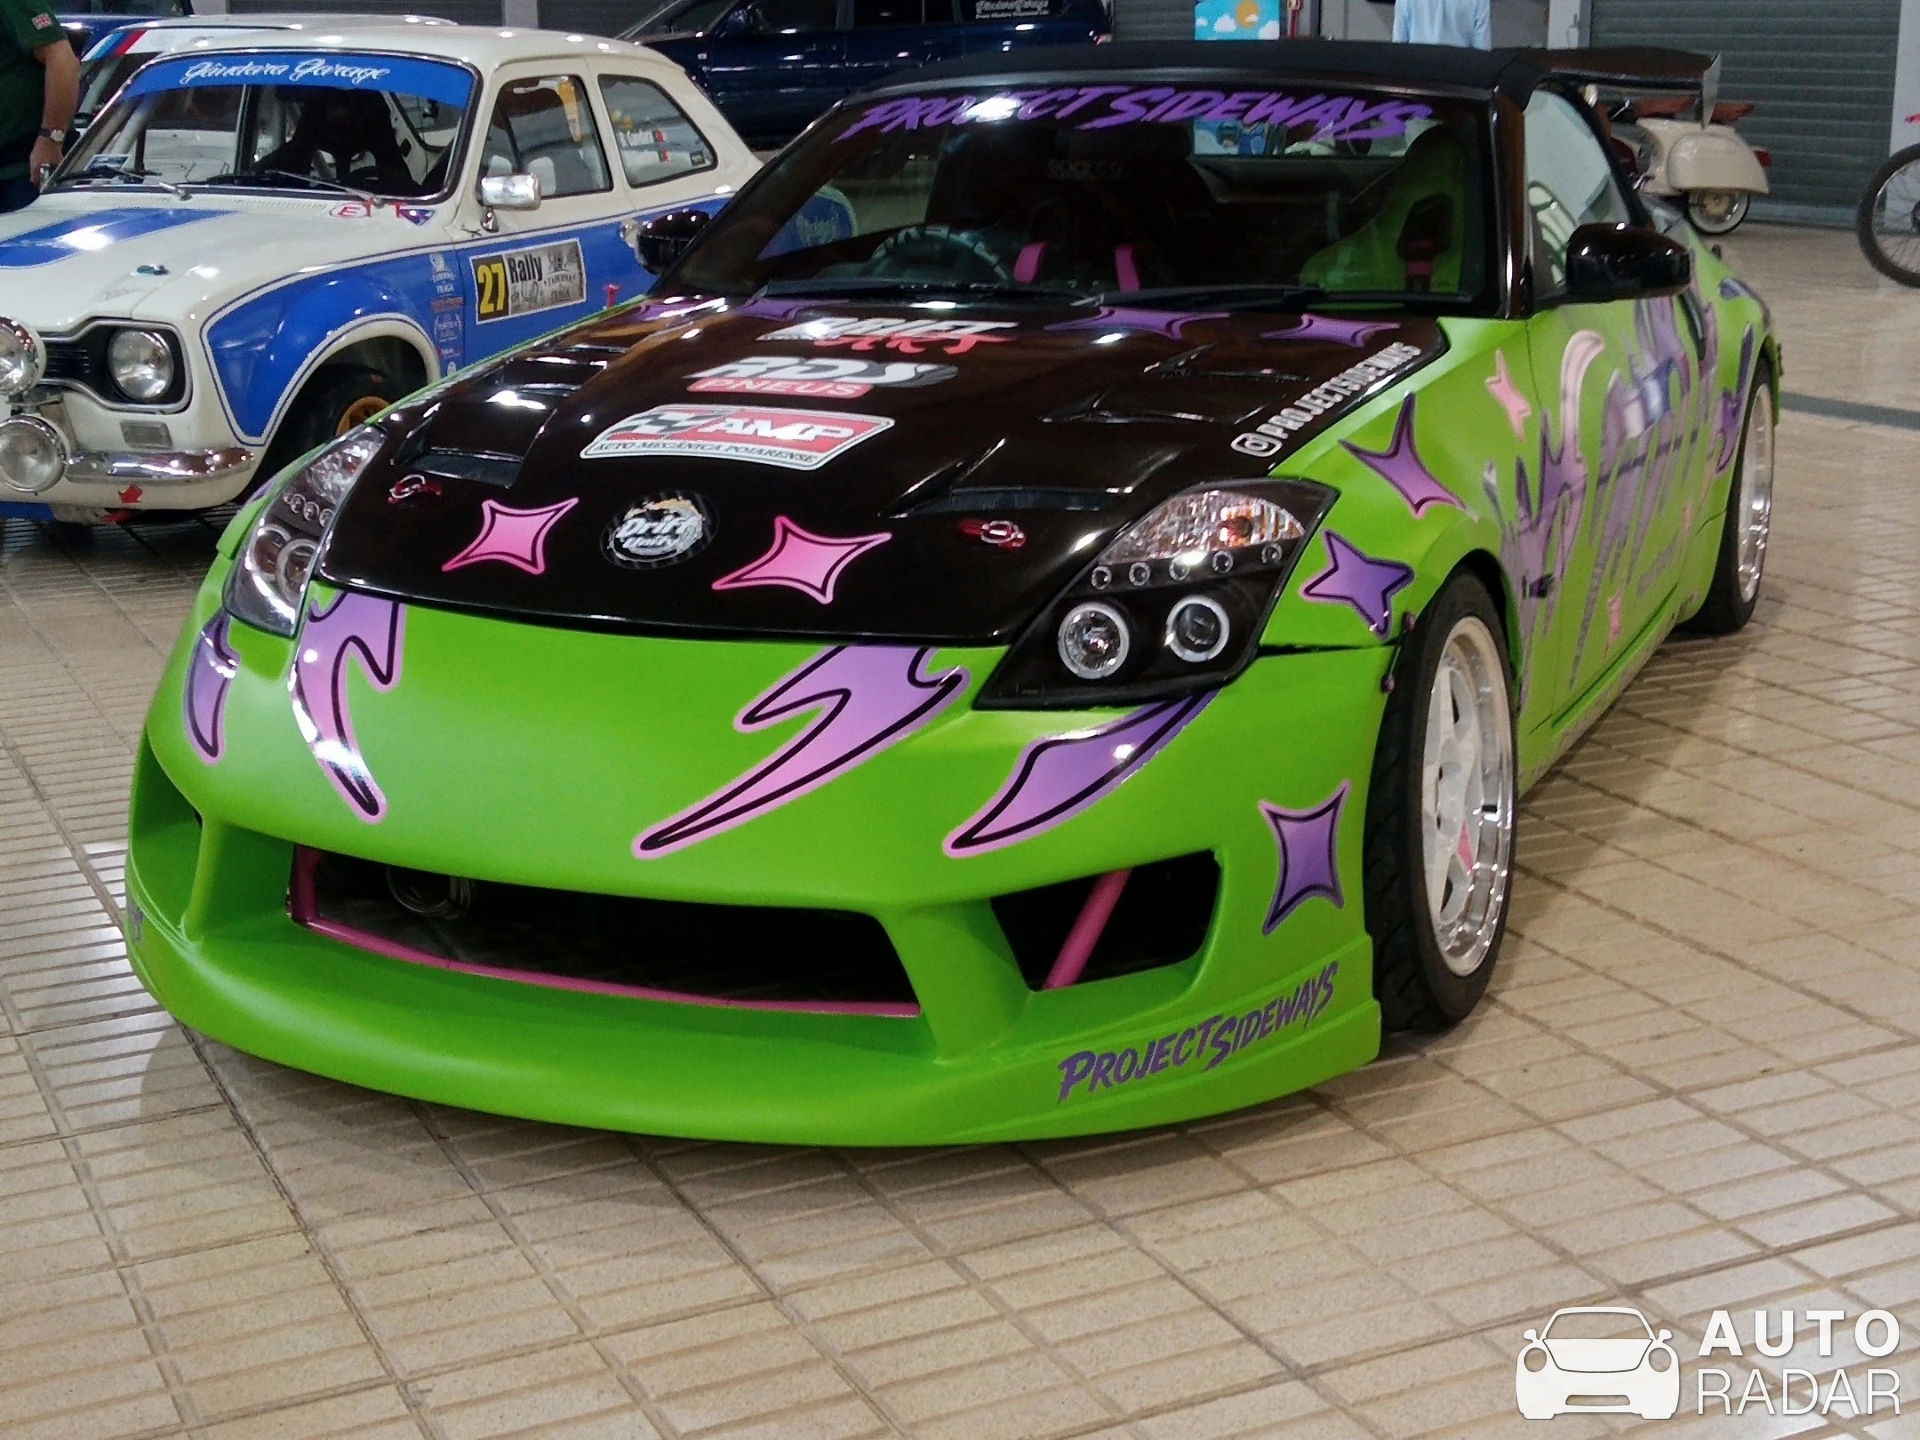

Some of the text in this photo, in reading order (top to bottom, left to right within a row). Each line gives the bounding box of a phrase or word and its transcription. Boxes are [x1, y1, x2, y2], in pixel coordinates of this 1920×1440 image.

[288, 58, 390, 84] Garage
[509, 253, 543, 284] Rally
[477, 262, 506, 314] 27
[695, 378, 858, 397] PNEUS
[697, 417, 855, 442] AMP
[596, 442, 635, 451] AUTO
